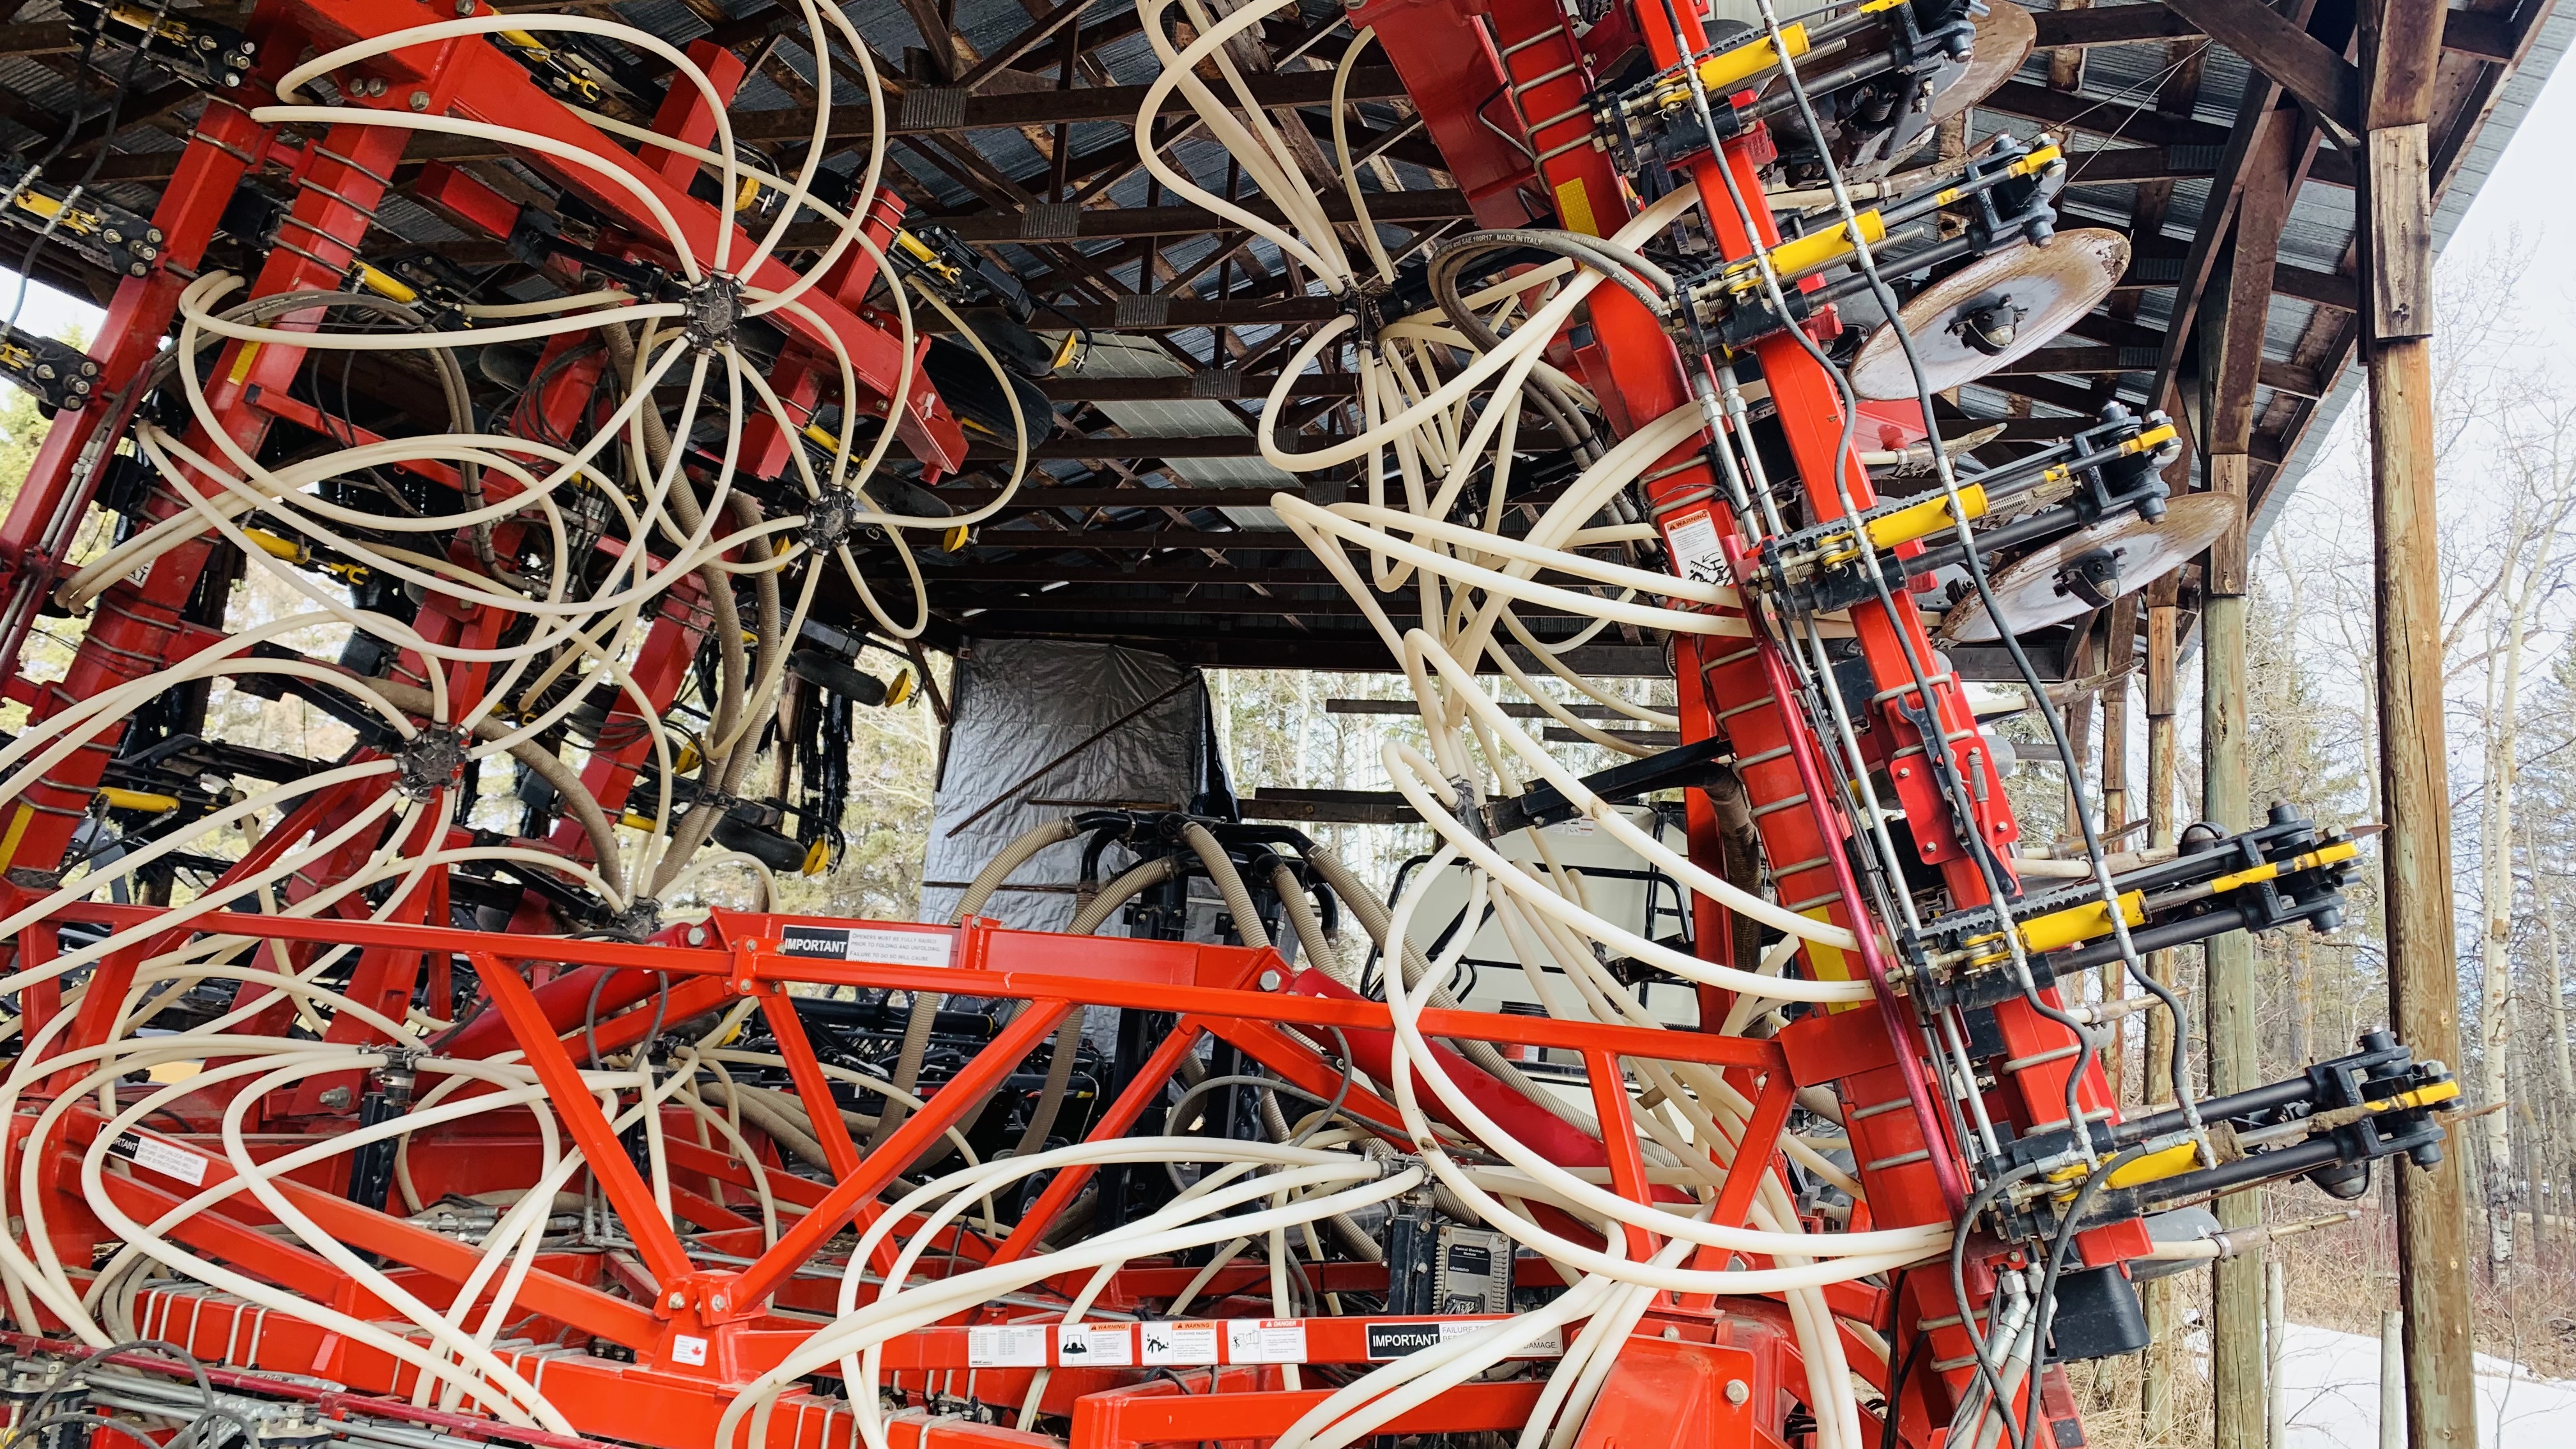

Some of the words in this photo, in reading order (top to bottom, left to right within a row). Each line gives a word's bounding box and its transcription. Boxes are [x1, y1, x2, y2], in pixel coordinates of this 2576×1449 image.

[1524, 236, 1543, 246] ITALY
[1579, 236, 1602, 247] ITALY
[1676, 512, 1707, 526] WARNING
[785, 938, 847, 953] IMPORTANT
[1372, 1333, 1438, 1347] IMPORTANT
